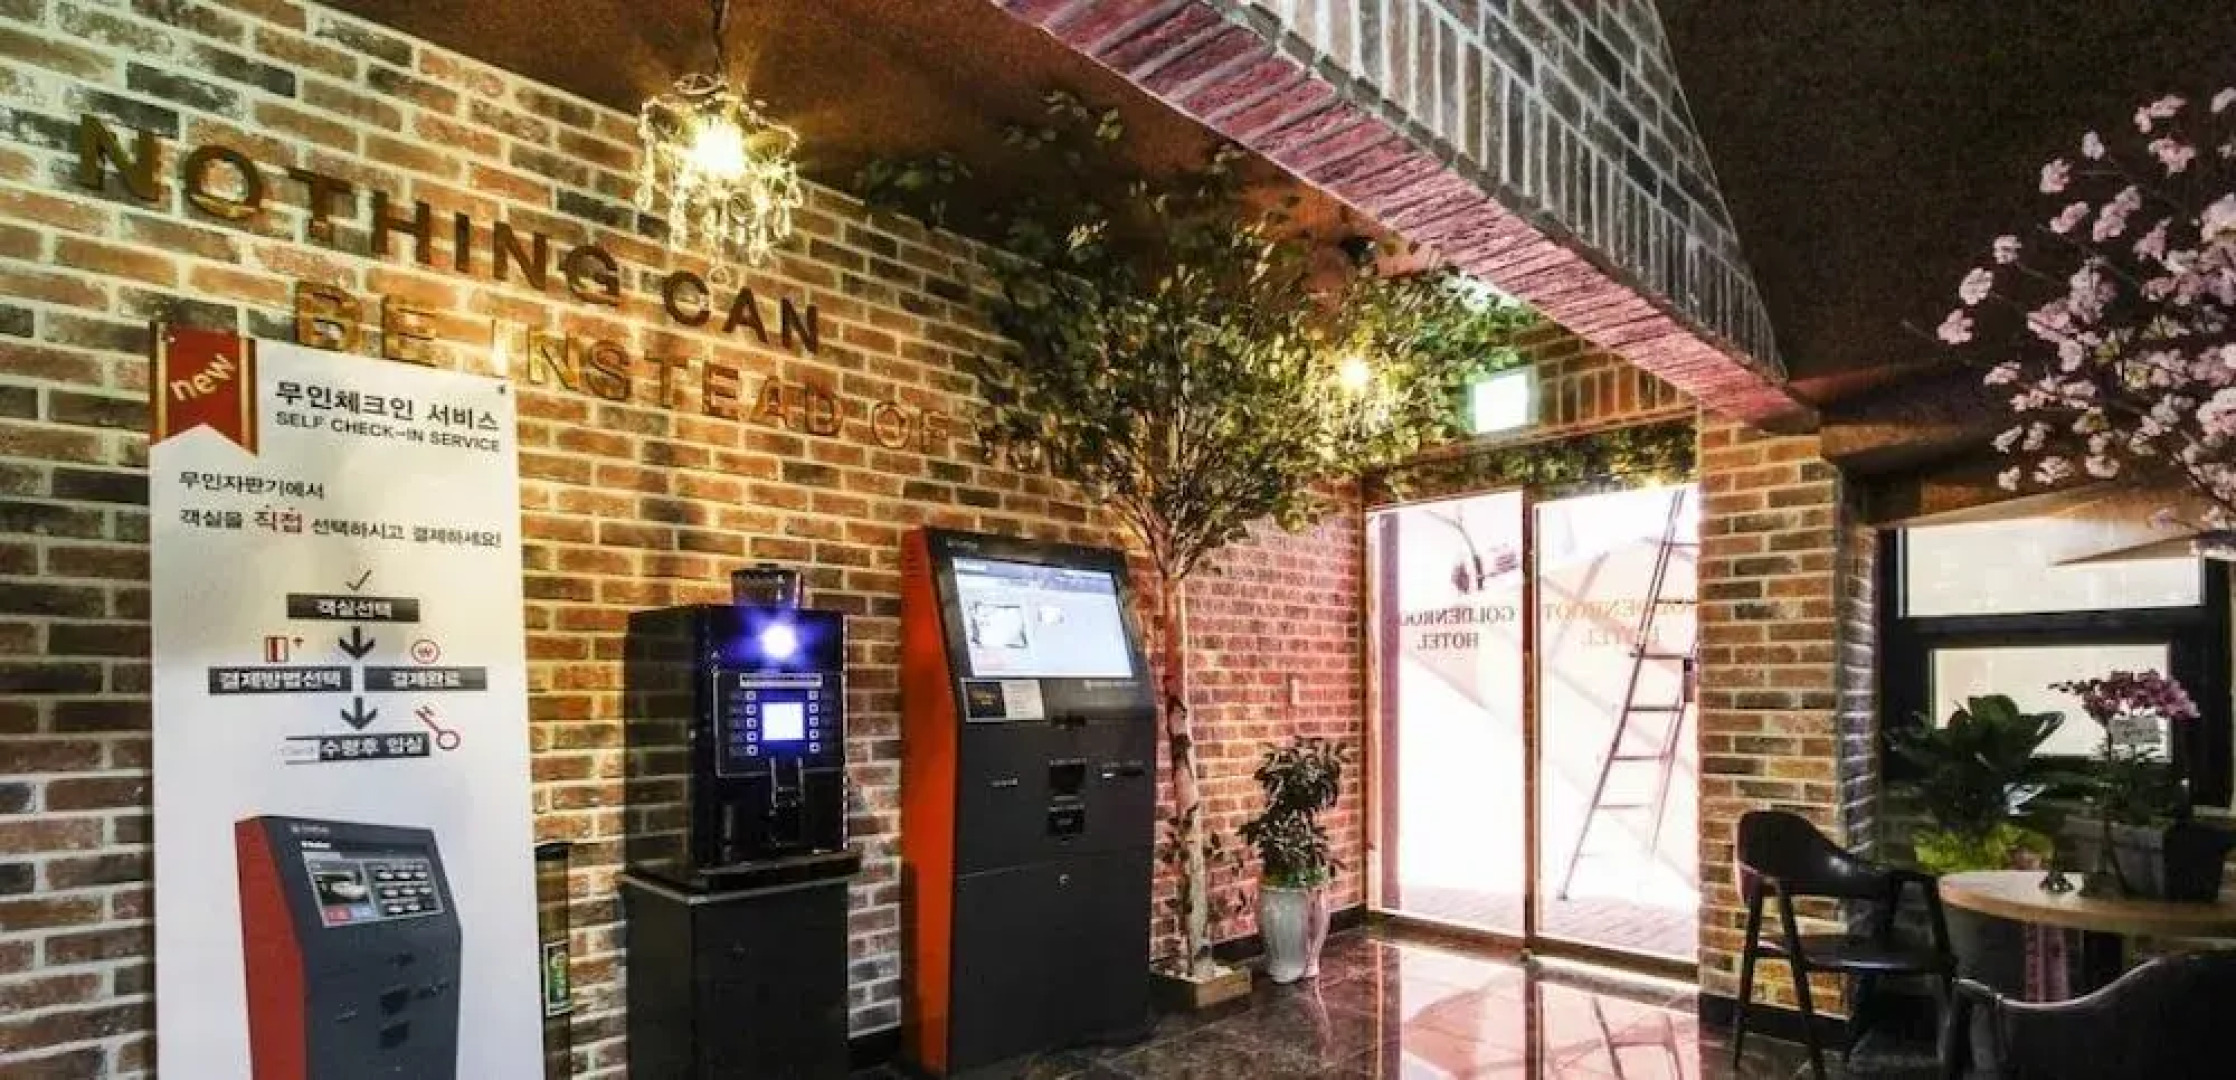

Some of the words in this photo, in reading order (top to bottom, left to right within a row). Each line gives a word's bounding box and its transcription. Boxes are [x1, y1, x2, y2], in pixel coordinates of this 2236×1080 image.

[76, 112, 621, 304] NOTHING
[662, 269, 819, 353] CAN
[169, 353, 235, 400] new
[294, 280, 438, 366] BE
[492, 317, 843, 436] INSTEAD
[871, 400, 950, 453] OF
[276, 381, 413, 421] 무인체크인
[427, 404, 499, 431] 서비스
[276, 411, 325, 429] SELF
[330, 417, 424, 442] CHECK-IN
[429, 431, 500, 453] SERVICE
[179, 471, 325, 500] 무인자판기에서
[179, 509, 243, 530] 객실을
[253, 507, 303, 534] 직접
[311, 517, 405, 541] 선택하시고
[317, 599, 392, 619] 객실선택
